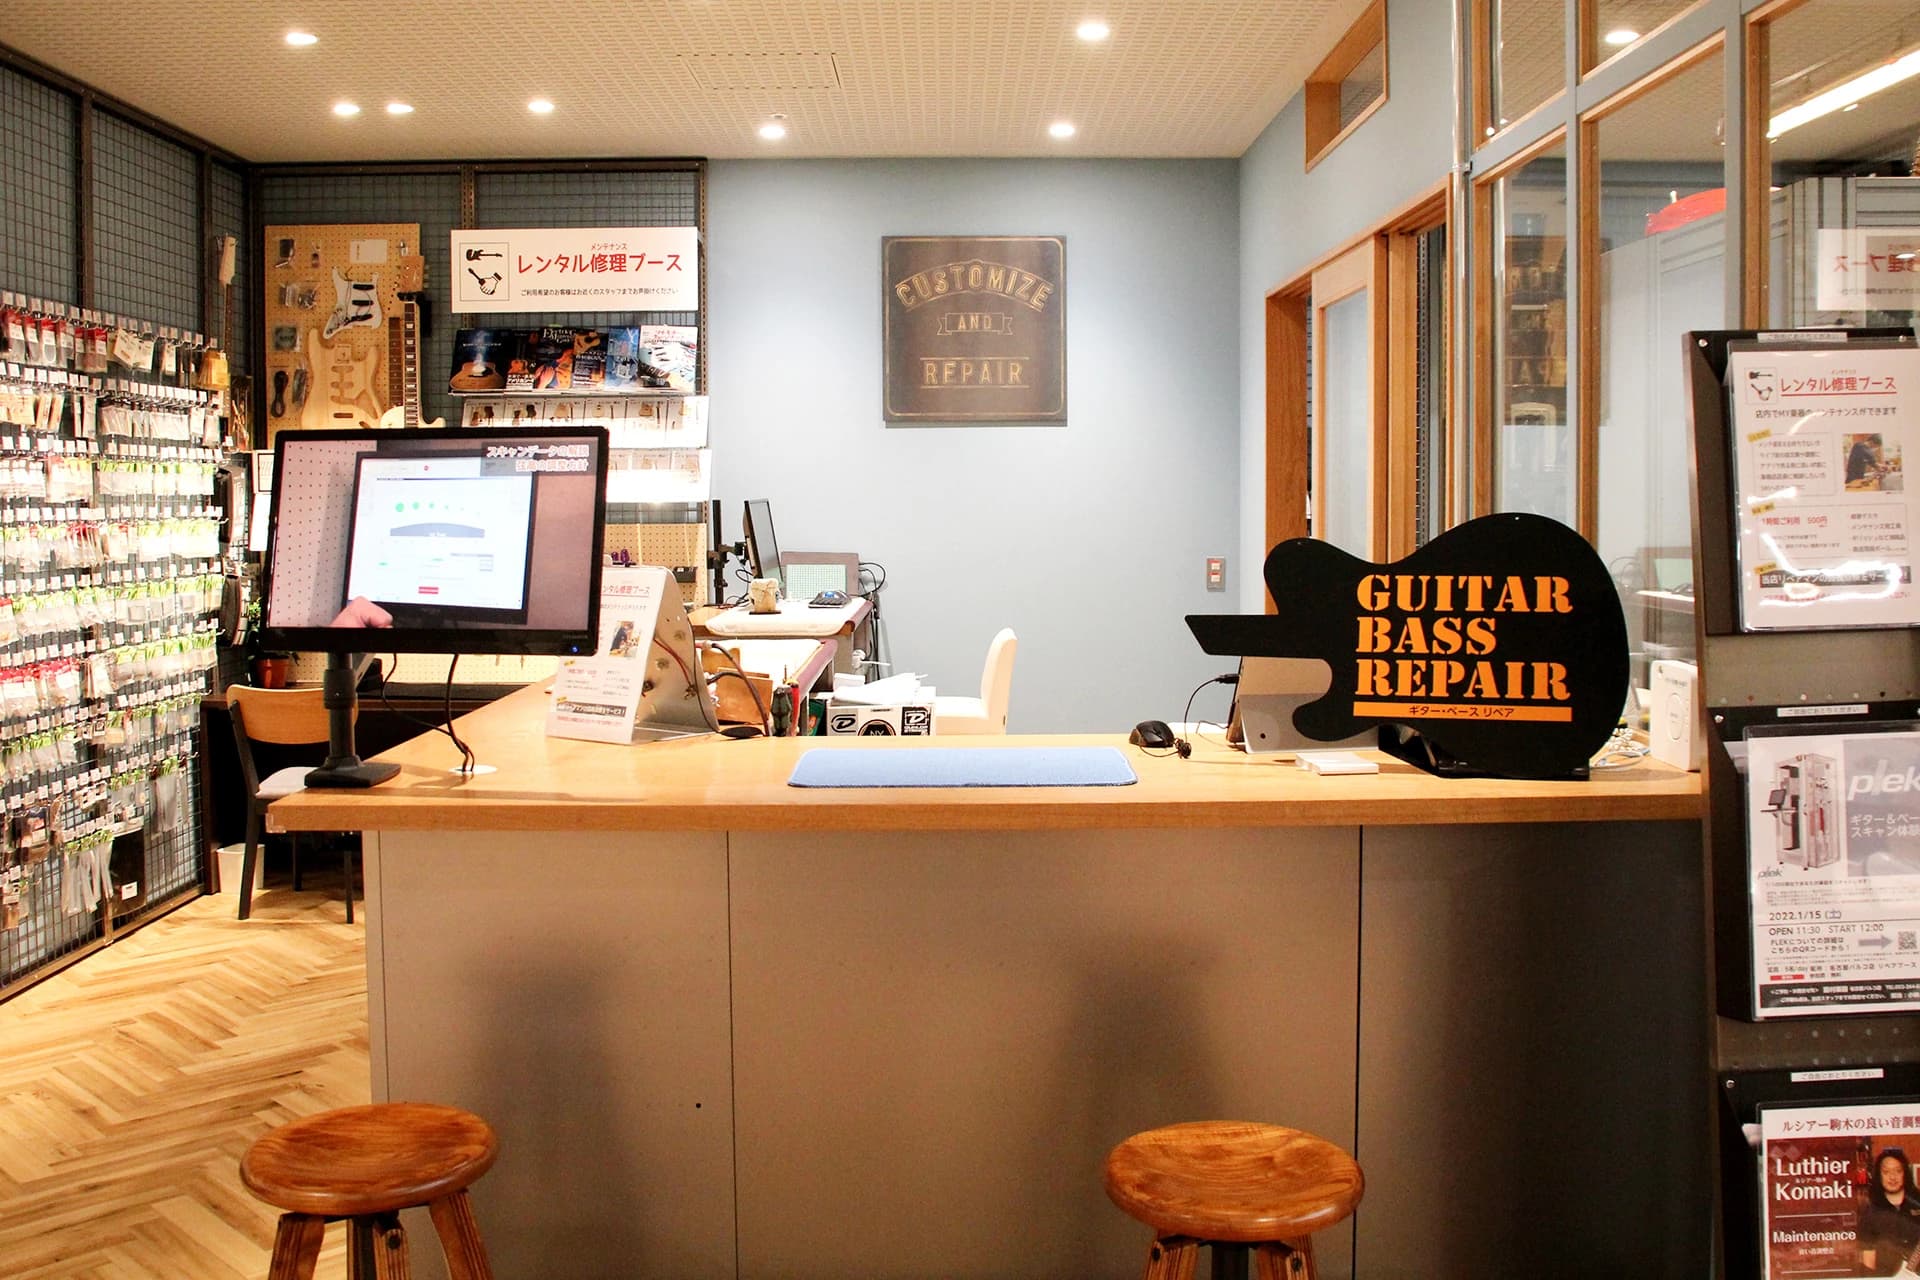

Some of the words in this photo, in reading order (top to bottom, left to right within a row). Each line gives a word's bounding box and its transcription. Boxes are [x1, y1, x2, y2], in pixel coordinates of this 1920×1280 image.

[591, 243, 628, 251] メンテナンス
[518, 253, 682, 274] レンタル修理ブース
[896, 264, 1054, 308] CUSTOMIZE
[957, 314, 993, 330] AND
[923, 360, 1023, 385] REPAIR
[1780, 376, 1897, 392] レンタル修理ブース
[1356, 574, 1573, 613] GUITAR
[1355, 616, 1497, 656] BASS
[1355, 658, 1571, 701] REPAIR
[1409, 705, 1479, 718] ギター・ベース
[1483, 707, 1515, 719] リペア
[1769, 910, 1822, 921] 2022.1/15
[1768, 927, 1794, 936] OPEN
[1828, 924, 1857, 933] START
[1860, 923, 1885, 932] 12:00
[1776, 1156, 1850, 1176] Luthier
[1776, 1180, 1852, 1201] Komaki
[1773, 1230, 1857, 1243] Maintenance
